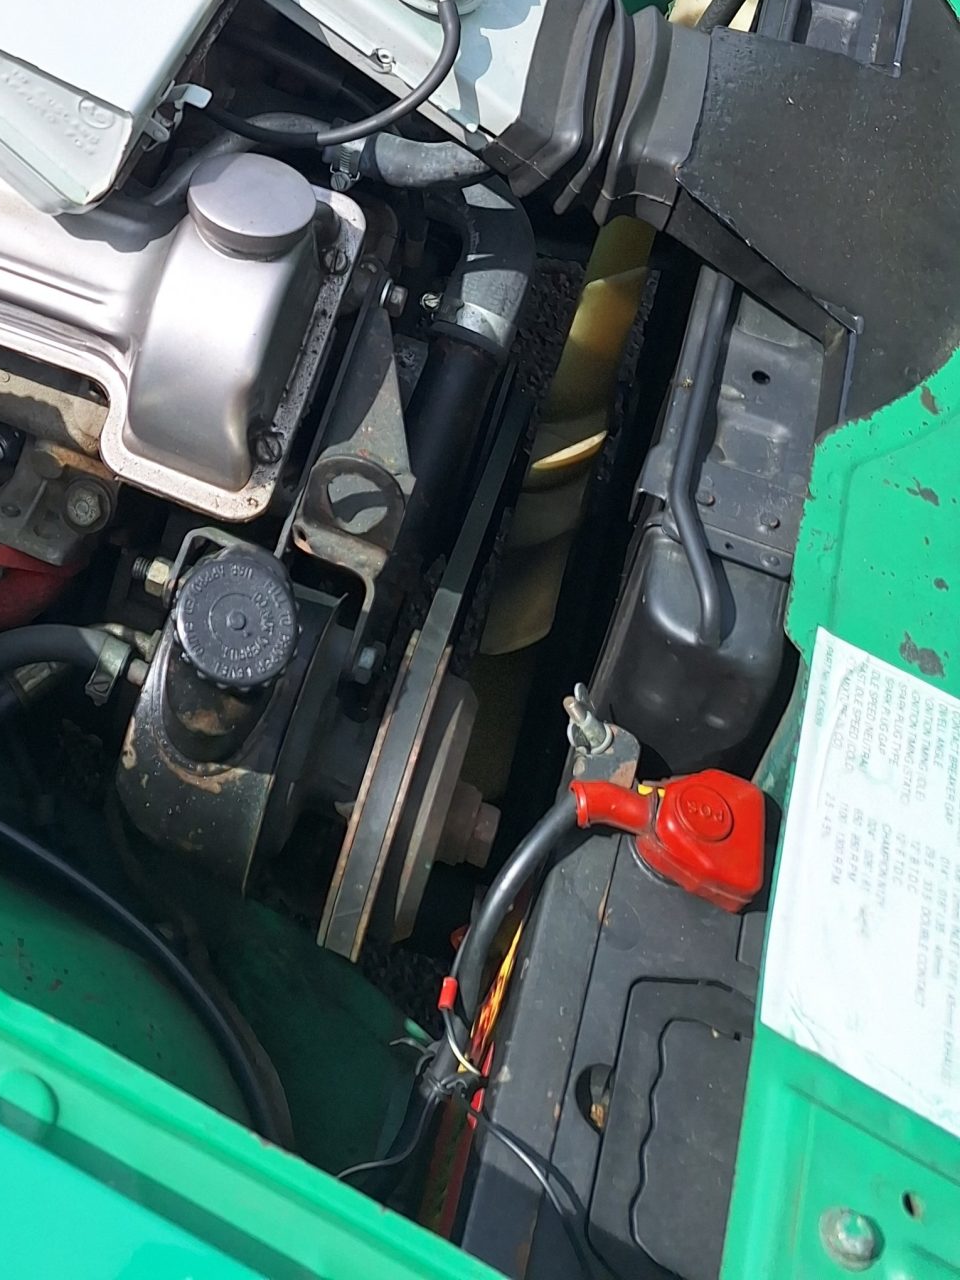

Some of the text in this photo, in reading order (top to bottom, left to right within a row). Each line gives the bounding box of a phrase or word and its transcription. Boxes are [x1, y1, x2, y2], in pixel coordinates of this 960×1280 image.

[865, 688, 878, 723] SPEED
[882, 674, 894, 706] SPARK
[895, 680, 907, 713] SPARK
[848, 705, 862, 741] SPEED
[878, 704, 891, 734] PLUG
[892, 711, 904, 741] PLUG
[876, 731, 887, 757] GAP
[888, 739, 901, 769] TYPE
[933, 735, 946, 771] ANGLE
